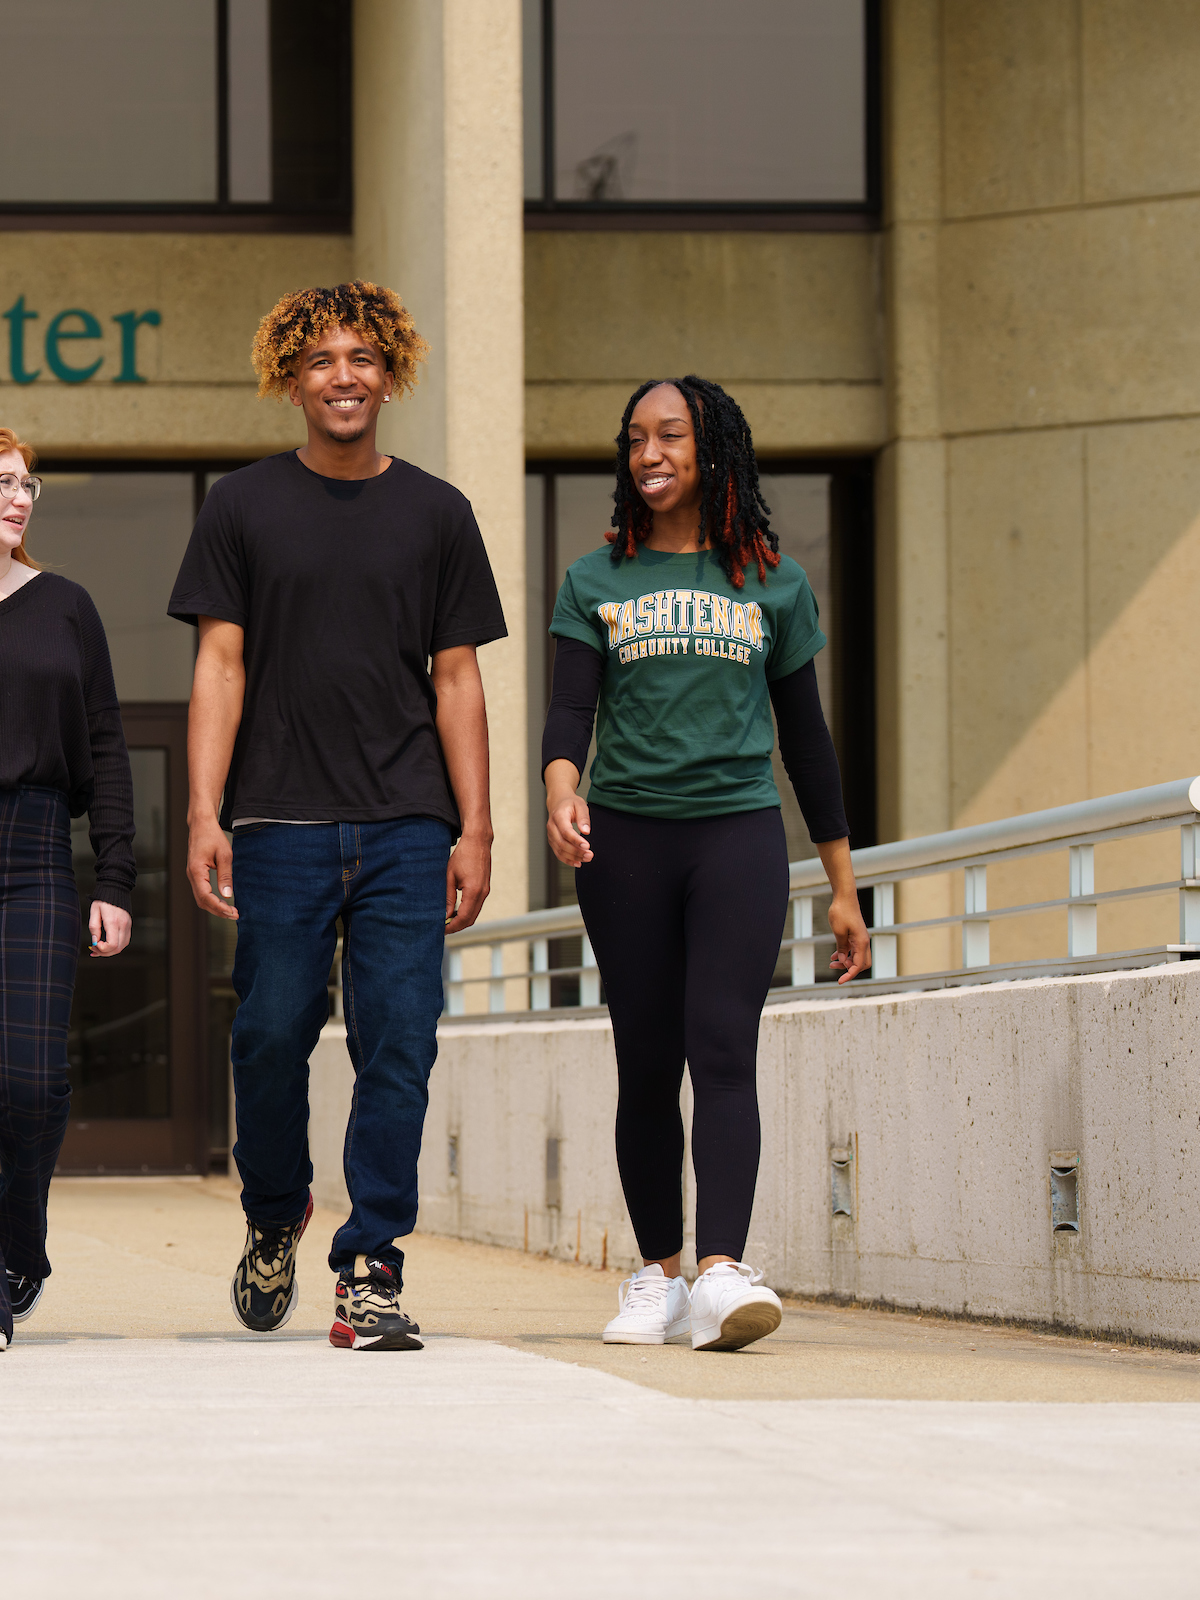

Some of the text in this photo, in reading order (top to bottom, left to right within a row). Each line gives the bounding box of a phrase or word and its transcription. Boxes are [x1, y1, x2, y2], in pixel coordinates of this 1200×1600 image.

[598, 589, 765, 652] WASHTENAW
[619, 638, 751, 665] COMMUNITY COLLEGE
